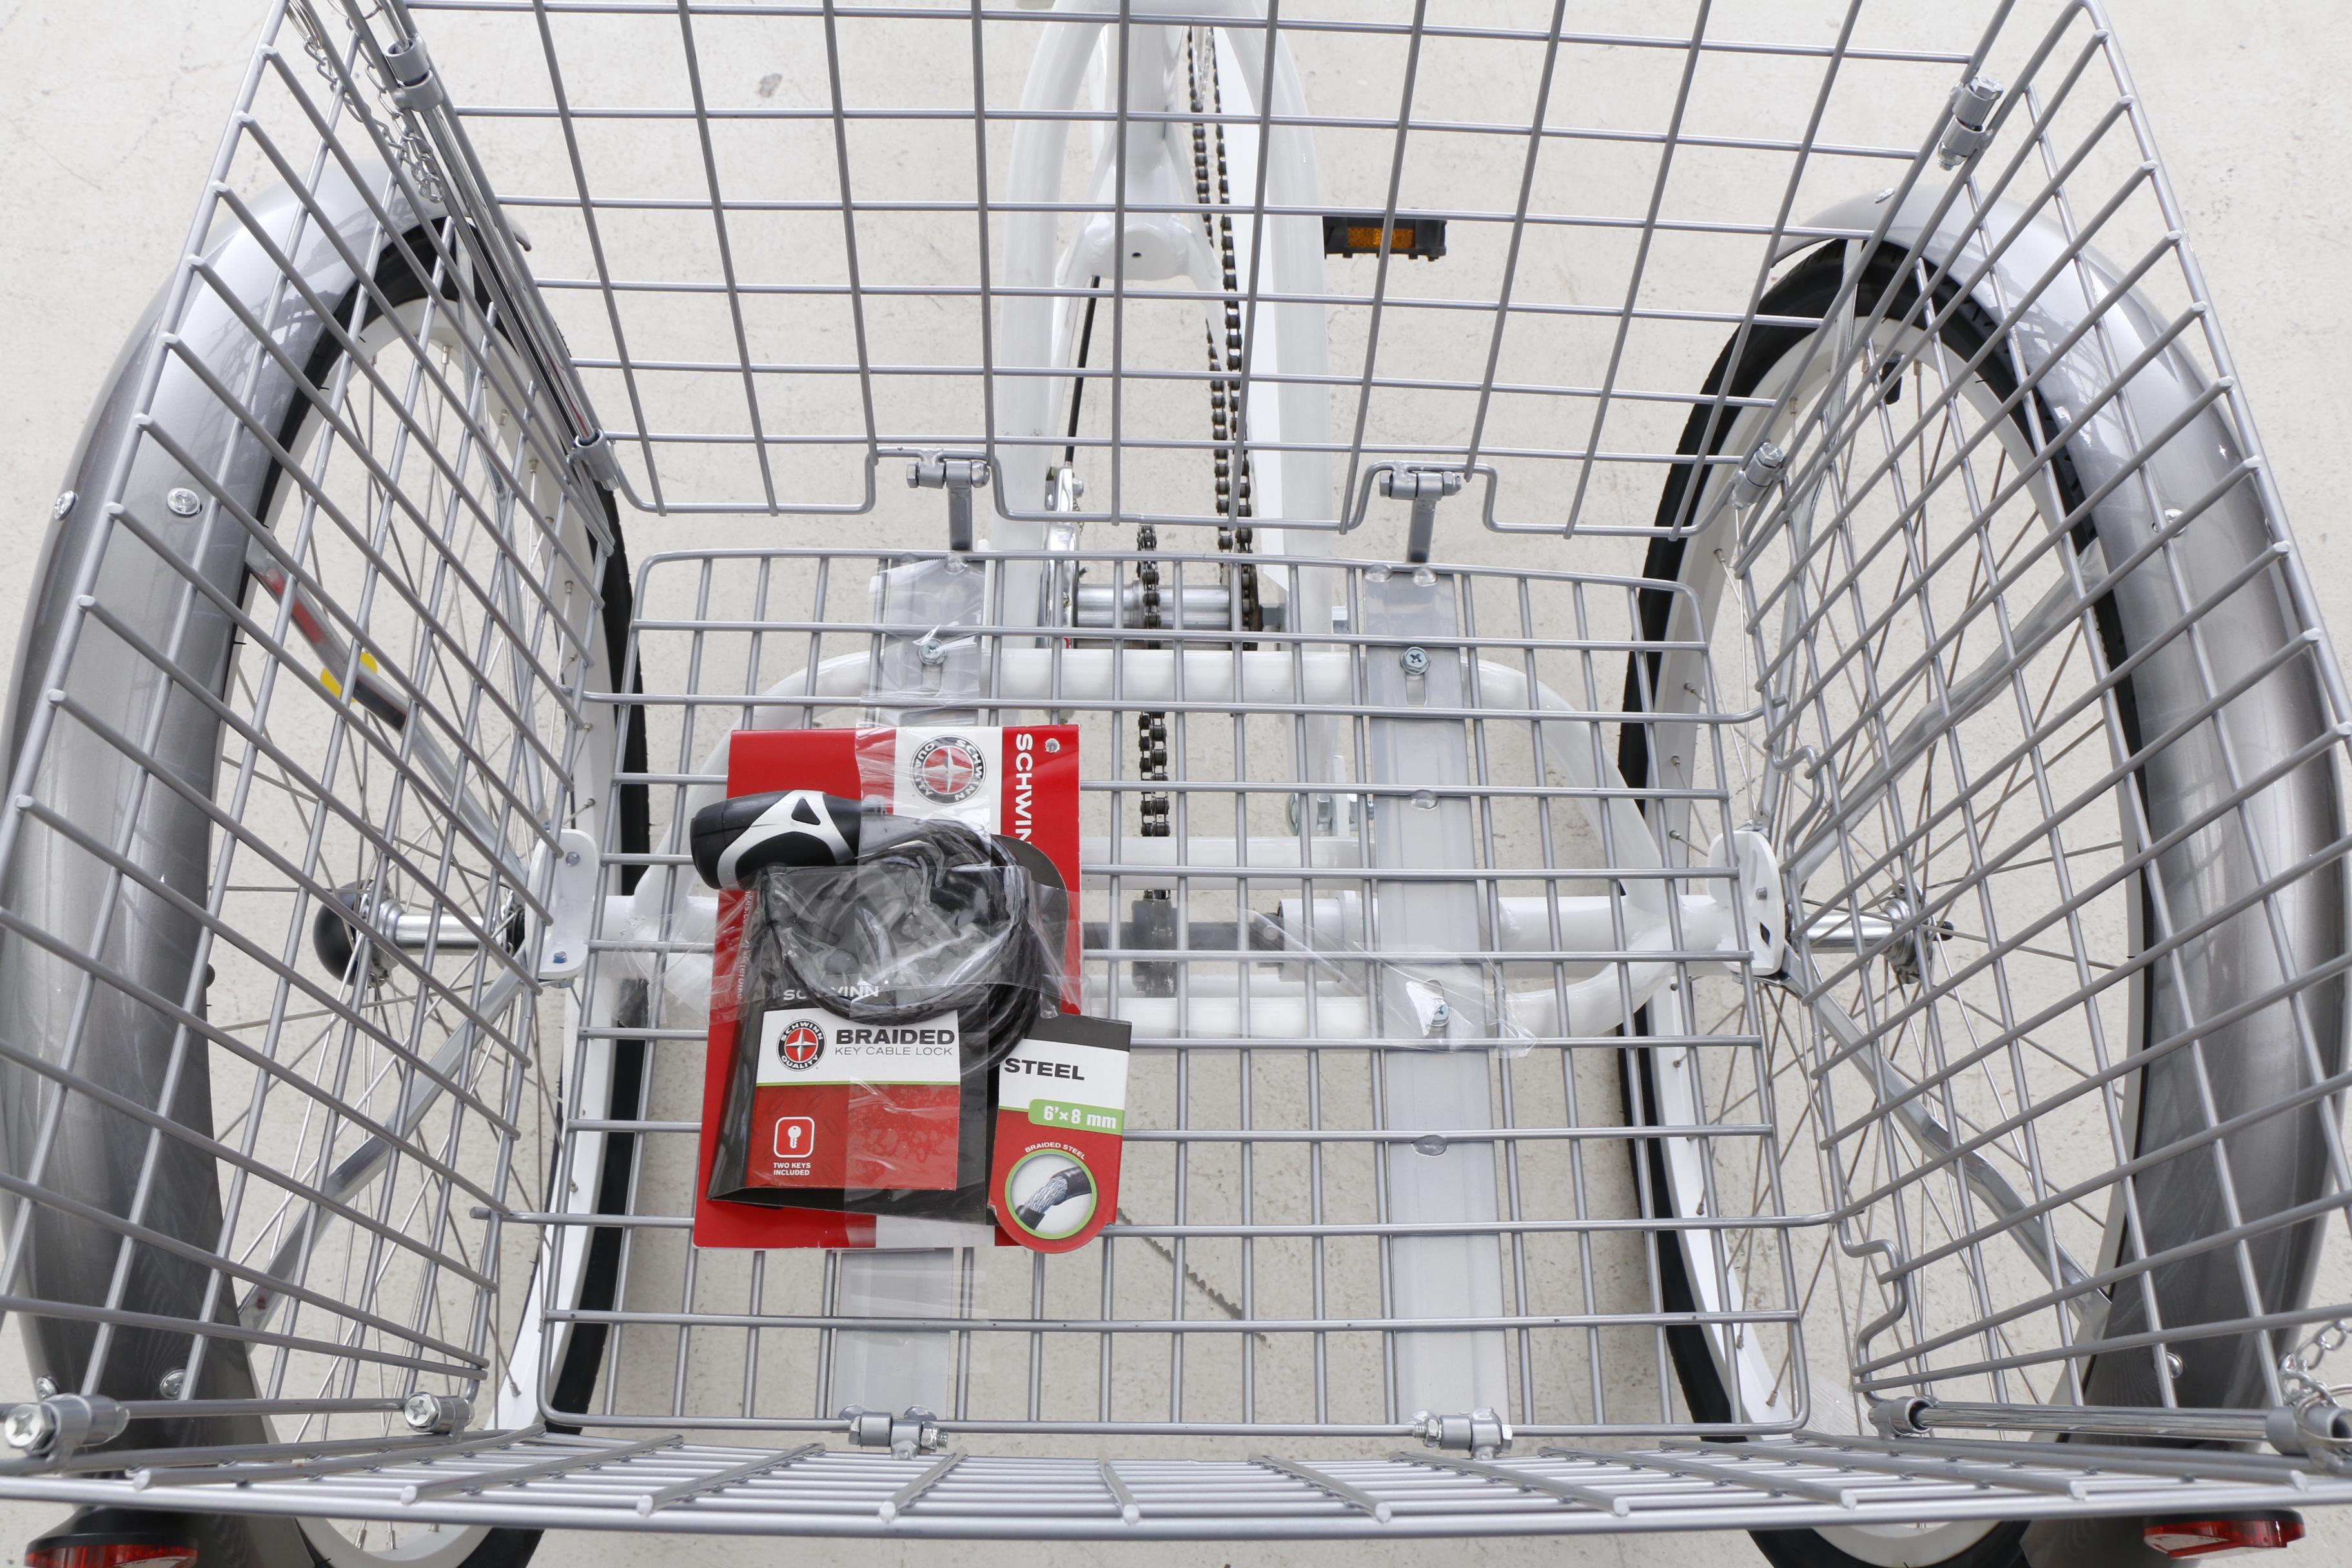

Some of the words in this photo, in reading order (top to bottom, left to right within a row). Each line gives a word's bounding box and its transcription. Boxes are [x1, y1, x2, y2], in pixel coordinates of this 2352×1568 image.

[1015, 733, 1033, 845] SCHWIN
[781, 1021, 823, 1041] SCHWINN
[836, 1029, 955, 1044] BRAIDED
[835, 1046, 861, 1055] KEY
[866, 1046, 911, 1055] CABLE
[916, 1046, 953, 1056] LOCK
[781, 1054, 818, 1069] QUALITY
[1004, 1057, 1085, 1081] STEEL
[1024, 1142, 1061, 1153] BRAIDED
[1062, 1144, 1085, 1161] STEEL
